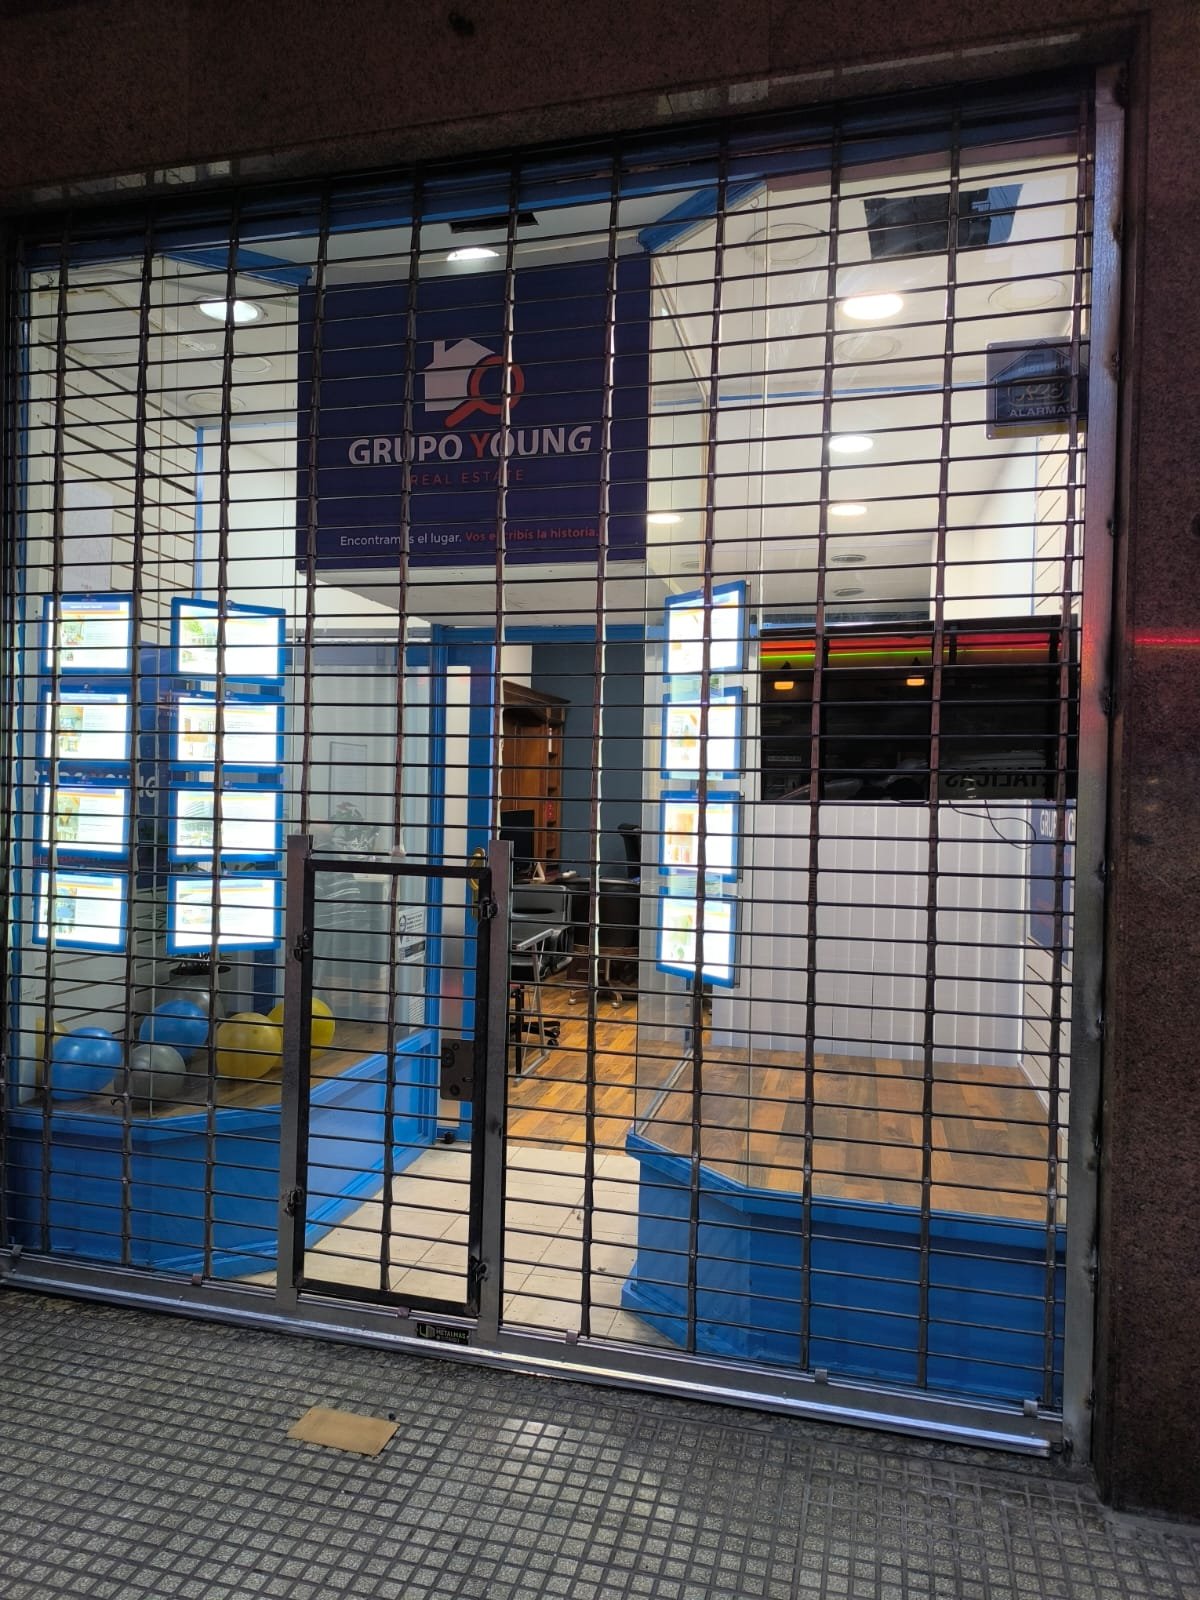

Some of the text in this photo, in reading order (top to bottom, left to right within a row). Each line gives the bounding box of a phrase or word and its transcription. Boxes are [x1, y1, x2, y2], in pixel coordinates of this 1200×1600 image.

[348, 425, 592, 465] GRUPO YOUNG
[410, 473, 453, 486] REAL
[340, 535, 415, 546] Encontrams
[417, 533, 428, 544] el
[431, 532, 462, 546] lugar.
[465, 531, 486, 542] Vos
[536, 528, 547, 540] la
[550, 526, 599, 539] historia.
